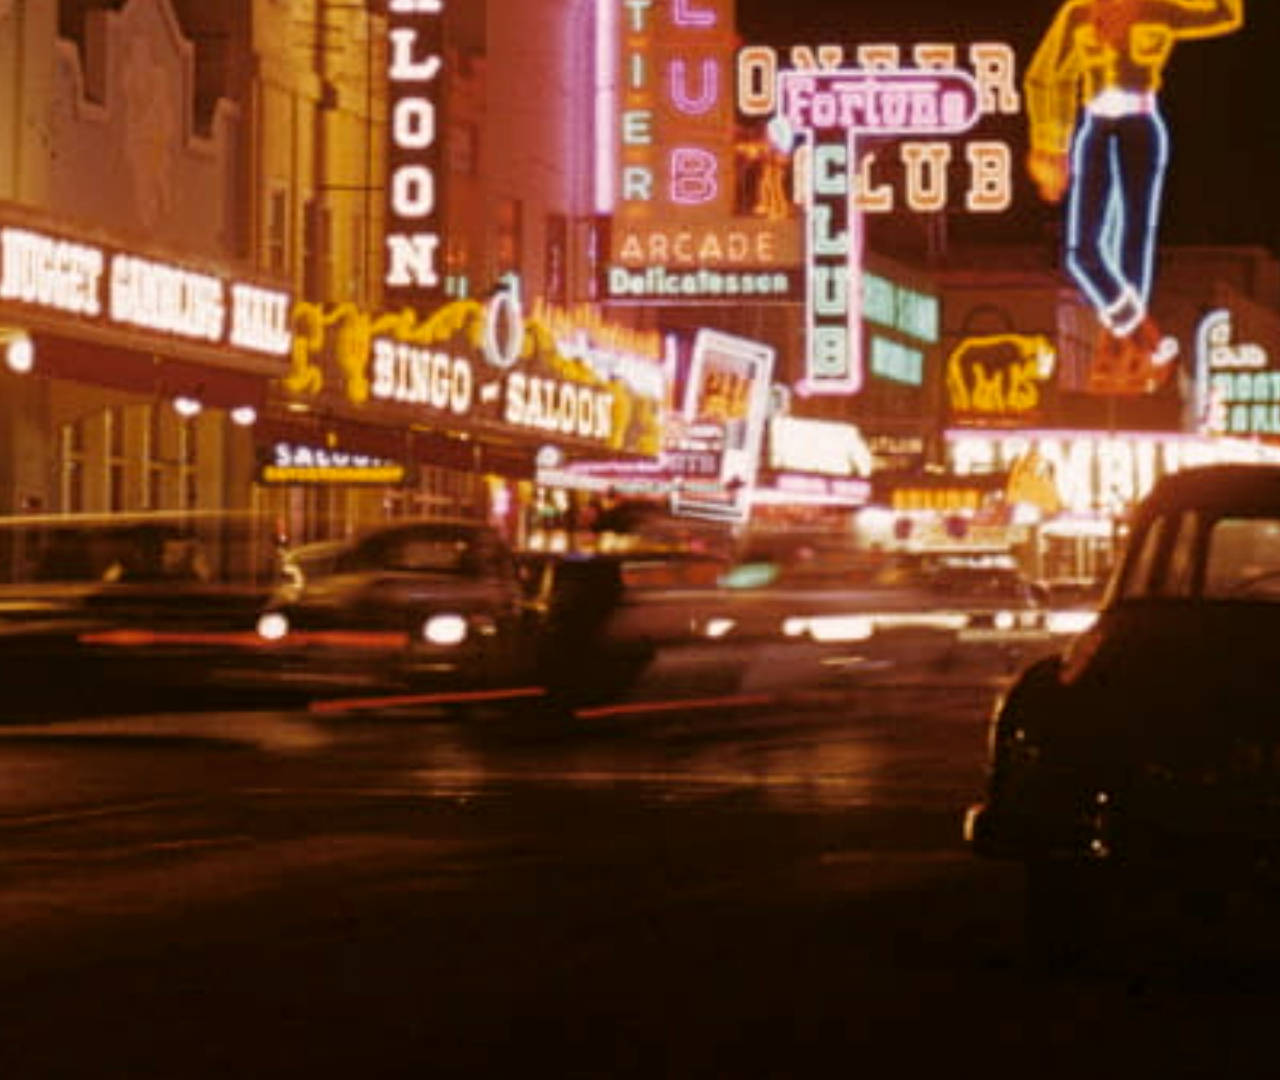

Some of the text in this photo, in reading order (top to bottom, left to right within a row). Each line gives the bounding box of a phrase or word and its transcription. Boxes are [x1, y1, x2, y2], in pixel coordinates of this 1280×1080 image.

[786, 75, 969, 128] Fortune
[608, 266, 789, 295] Delicatessen
[620, 231, 776, 263] ARCADE
[812, 144, 848, 377] CLUB
[108, 252, 226, 342] GAMBLING
[229, 280, 294, 356] HALL
[372, 338, 472, 414] BINGO
[505, 371, 614, 438] SALOON
